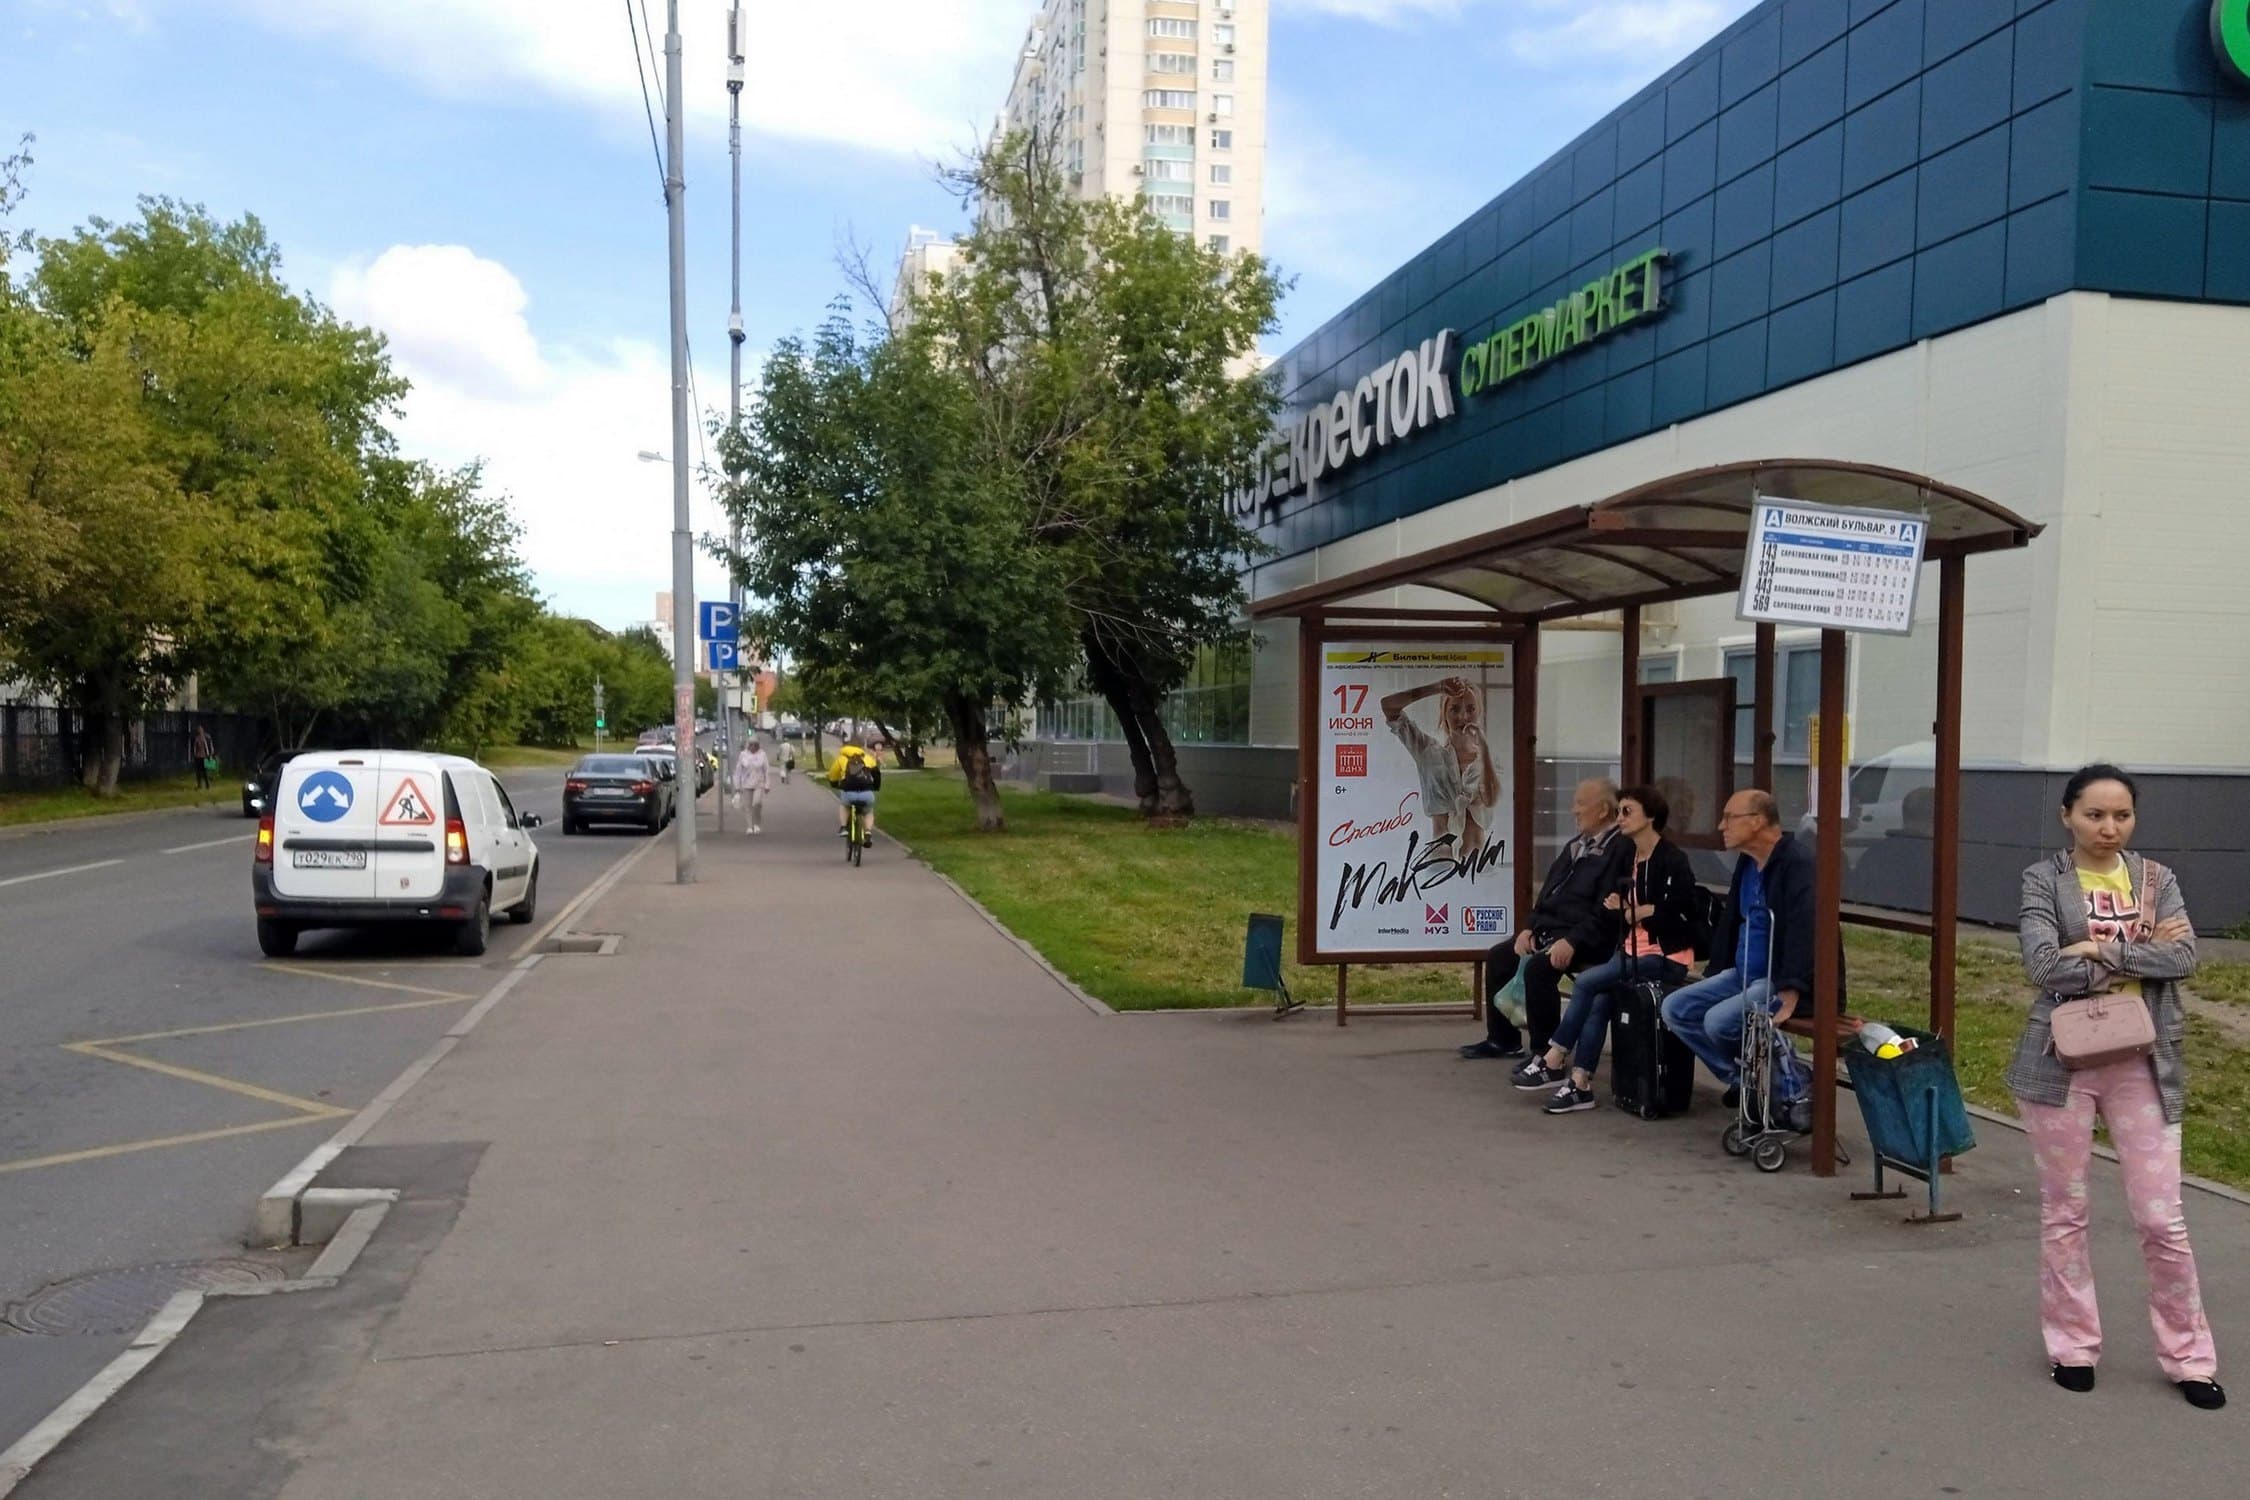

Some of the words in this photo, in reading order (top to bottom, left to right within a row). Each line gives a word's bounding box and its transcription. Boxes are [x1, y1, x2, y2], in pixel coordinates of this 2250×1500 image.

[1461, 248, 1669, 397] СУПЕРМАРКЕТ
[1785, 513, 1839, 529] ВОЛЖСКИЙ
[1889, 525, 1896, 535] 9
[1762, 543, 1777, 560] 143
[1758, 560, 1775, 577] 334
[1755, 577, 1773, 595] 443
[1753, 595, 1770, 612] 569
[711, 606, 733, 638] P
[716, 644, 733, 668] P
[1393, 653, 1430, 662] Билеты
[1333, 685, 1369, 714] 17
[1329, 717, 1373, 730] ИЮНЯ
[1335, 785, 1347, 795] 6+
[1329, 791, 1419, 847] Спасибо
[1477, 909, 1504, 920] РУССКОЕ
[1425, 926, 1449, 935] МУЗ
[1477, 921, 1497, 931] РАДИО
